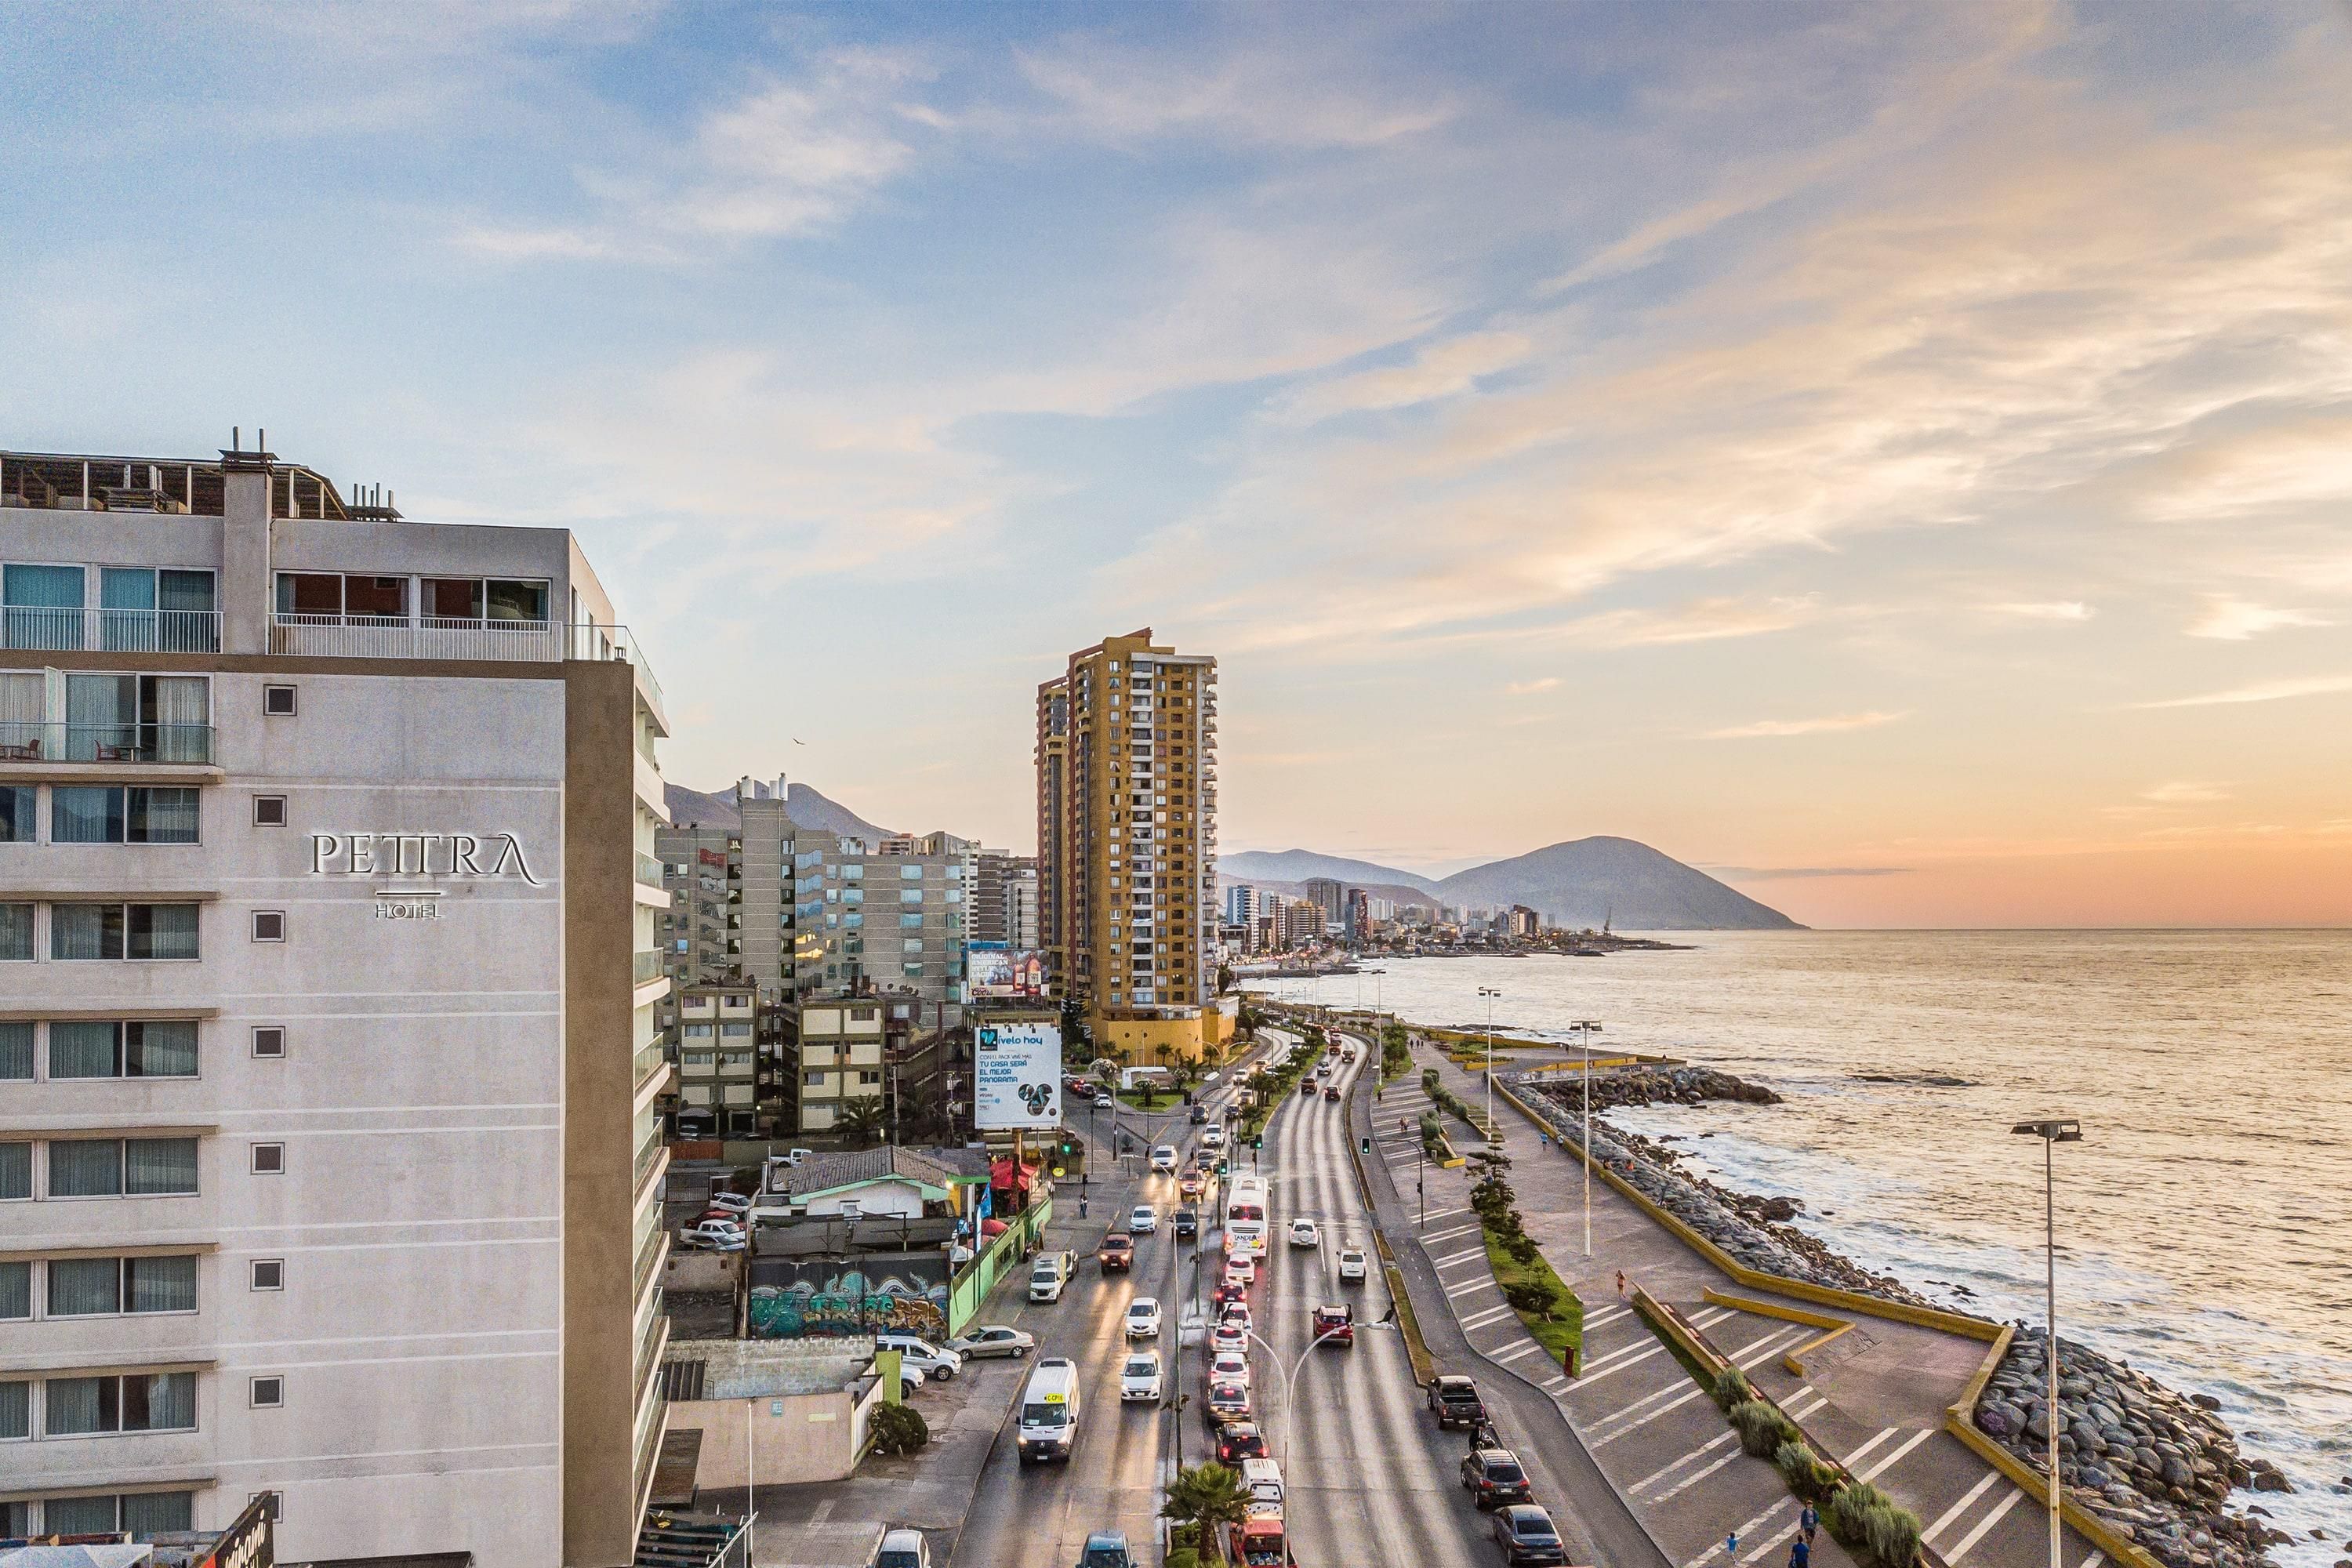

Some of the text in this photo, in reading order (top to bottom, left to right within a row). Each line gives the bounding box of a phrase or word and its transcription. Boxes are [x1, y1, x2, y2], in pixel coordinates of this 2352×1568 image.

[376, 904, 441, 920] HOTEL
[971, 986, 993, 996] Coors
[1023, 1036, 1043, 1045] hoy
